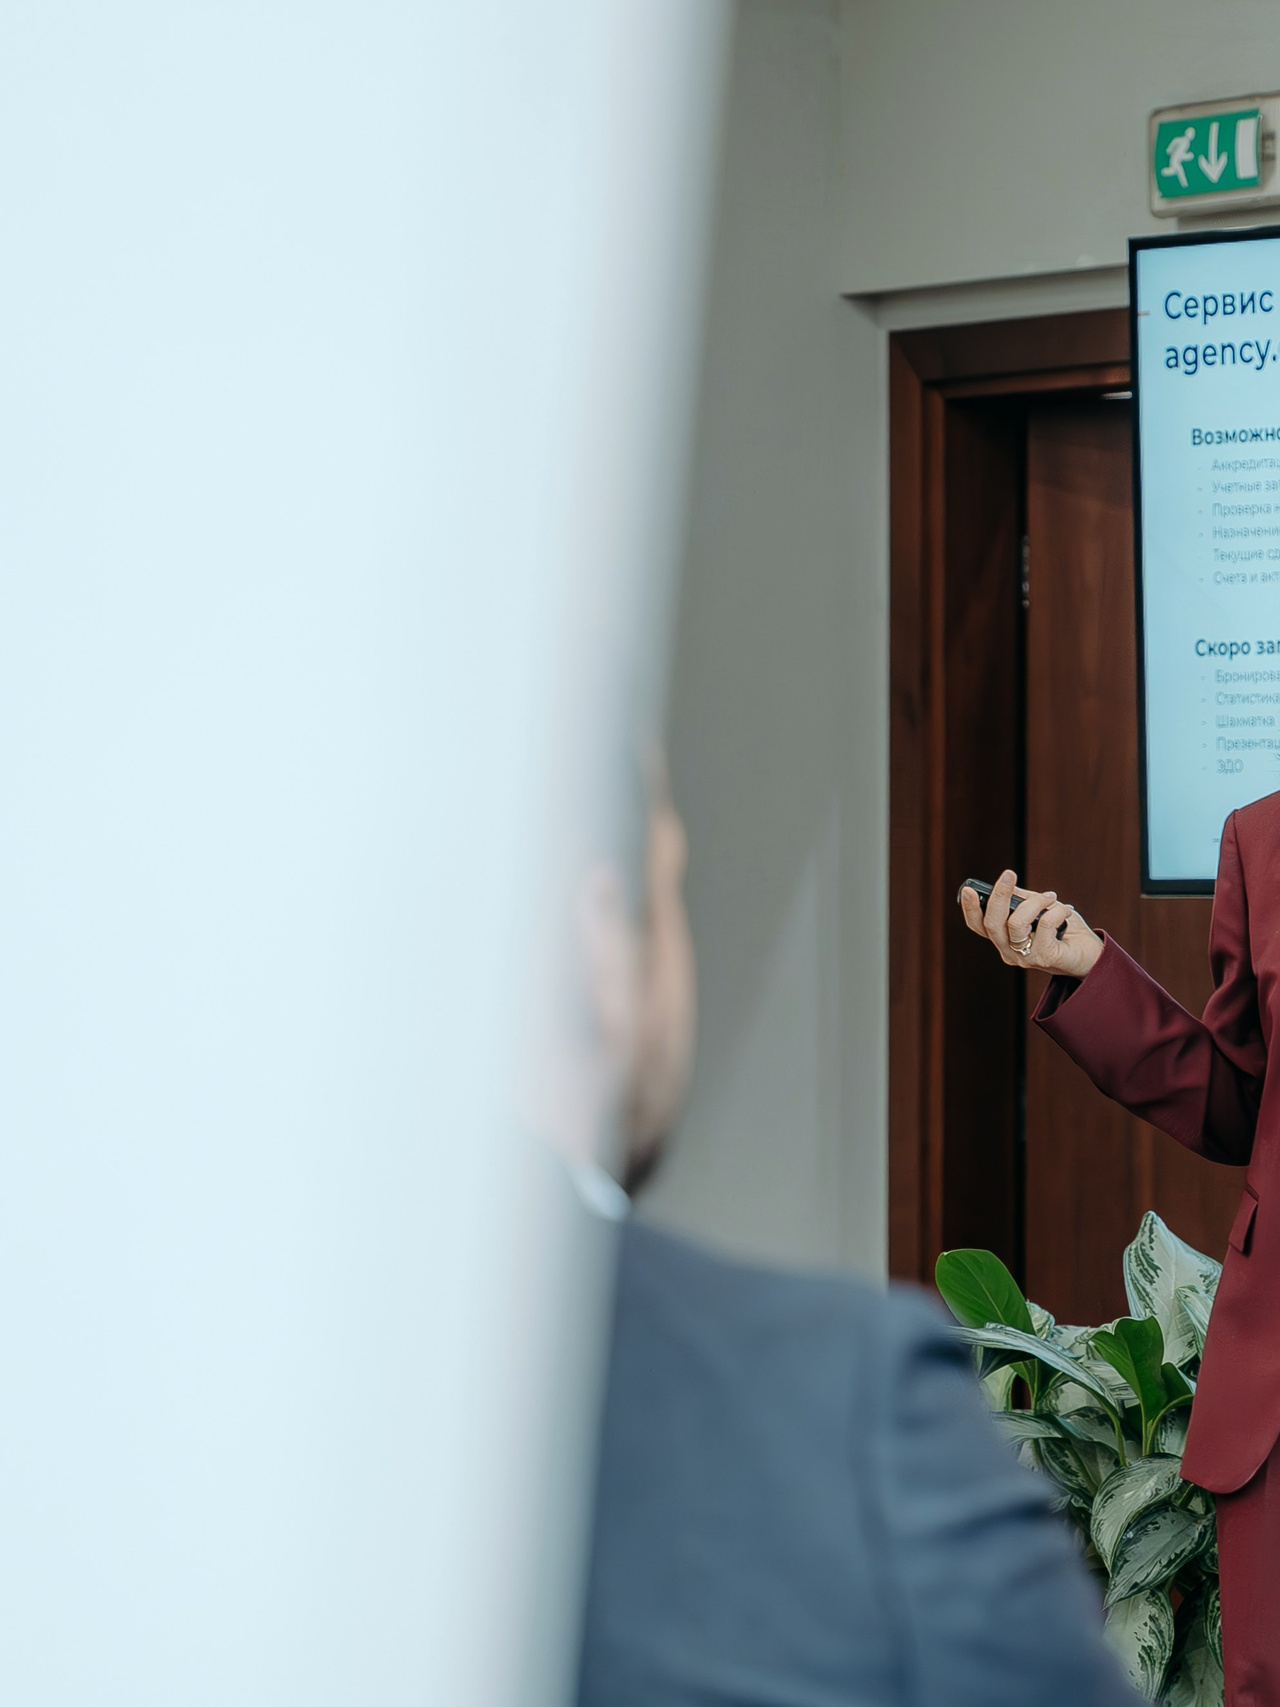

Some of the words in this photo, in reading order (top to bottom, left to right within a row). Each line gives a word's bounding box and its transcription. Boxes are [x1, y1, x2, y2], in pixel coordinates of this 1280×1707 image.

[1164, 288, 1274, 325] Сервис
[1212, 480, 1261, 493] Учетные
[1212, 502, 1271, 518] Проверка
[1213, 547, 1264, 563] Текущие
[1213, 571, 1247, 585] Счета
[1250, 572, 1258, 583] и
[1194, 638, 1251, 660] Скоро
[1215, 691, 1280, 705] Статистика
[1215, 715, 1276, 728] Шахматка
[1215, 759, 1244, 774] ЭДО
